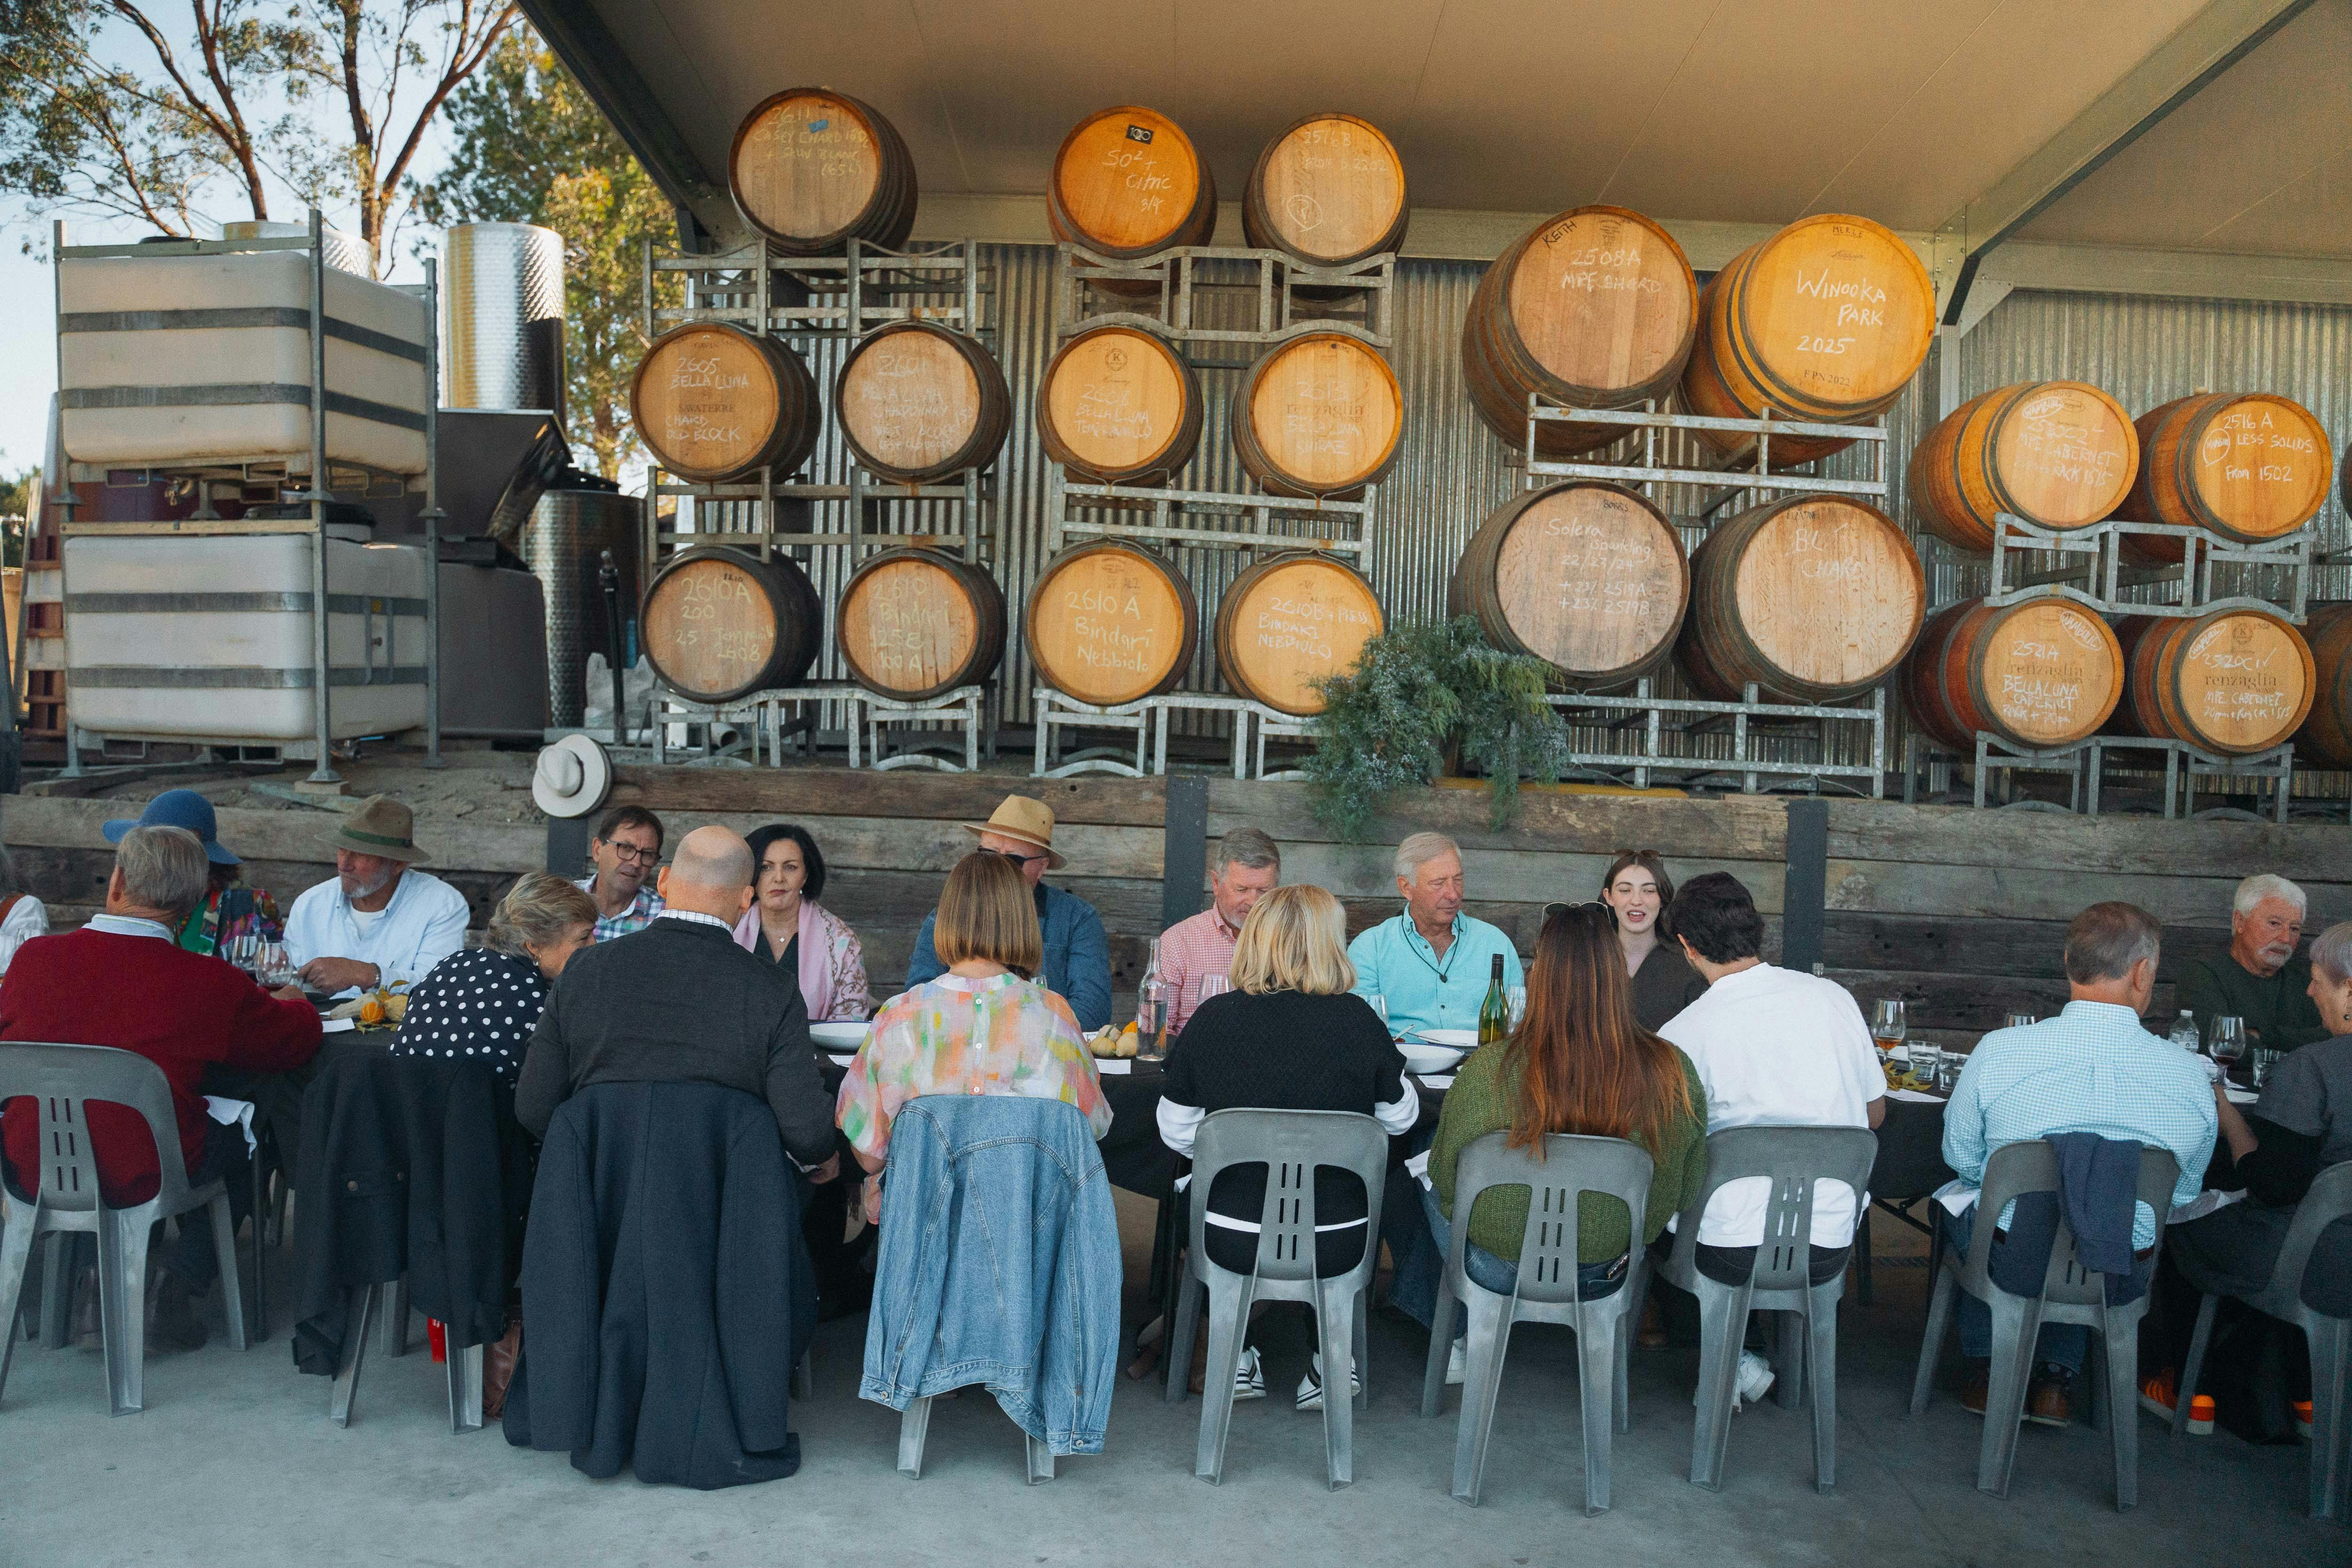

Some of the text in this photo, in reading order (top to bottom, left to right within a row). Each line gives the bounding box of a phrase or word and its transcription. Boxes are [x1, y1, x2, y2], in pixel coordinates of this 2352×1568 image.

[1541, 220, 1577, 249] KEITH
[1797, 335, 1856, 354] 2025
[675, 357, 721, 374] 2605
[669, 374, 749, 390] BELLA LUNA
[2224, 411, 2273, 429] 2516 A
[694, 426, 740, 442] BLOCK
[2237, 433, 2313, 454] LESS SOLIDS
[2259, 465, 2293, 482] 1502
[1545, 517, 1604, 538] Solera
[1065, 589, 1141, 620] 2610 A
